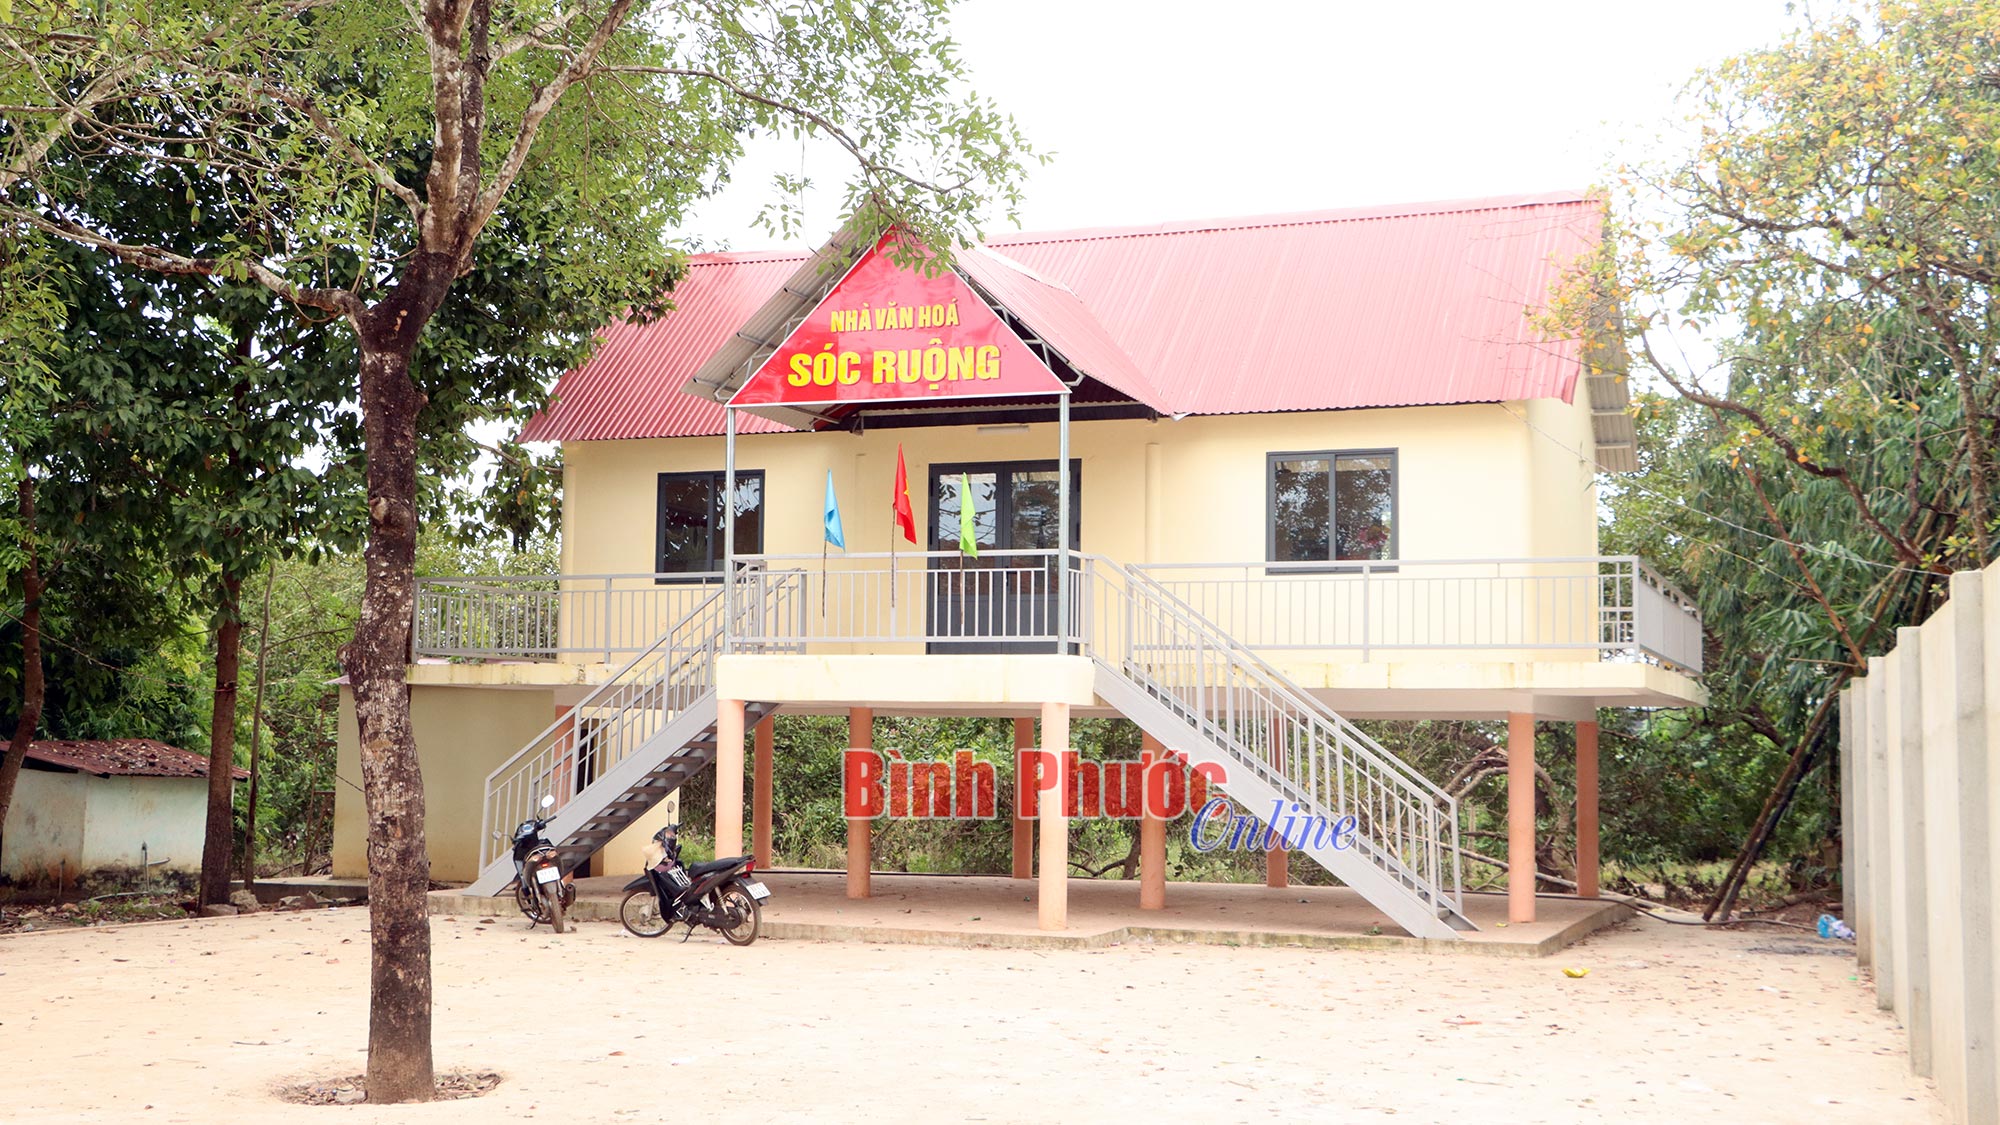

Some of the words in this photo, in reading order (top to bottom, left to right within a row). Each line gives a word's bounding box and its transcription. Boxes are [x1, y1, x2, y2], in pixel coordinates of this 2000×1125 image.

[831, 302, 872, 332] NHÀ
[875, 301, 914, 331] VĂN
[918, 298, 959, 327] HOÁ
[788, 344, 861, 387] SÓC
[873, 338, 1001, 389] RUỘNG
